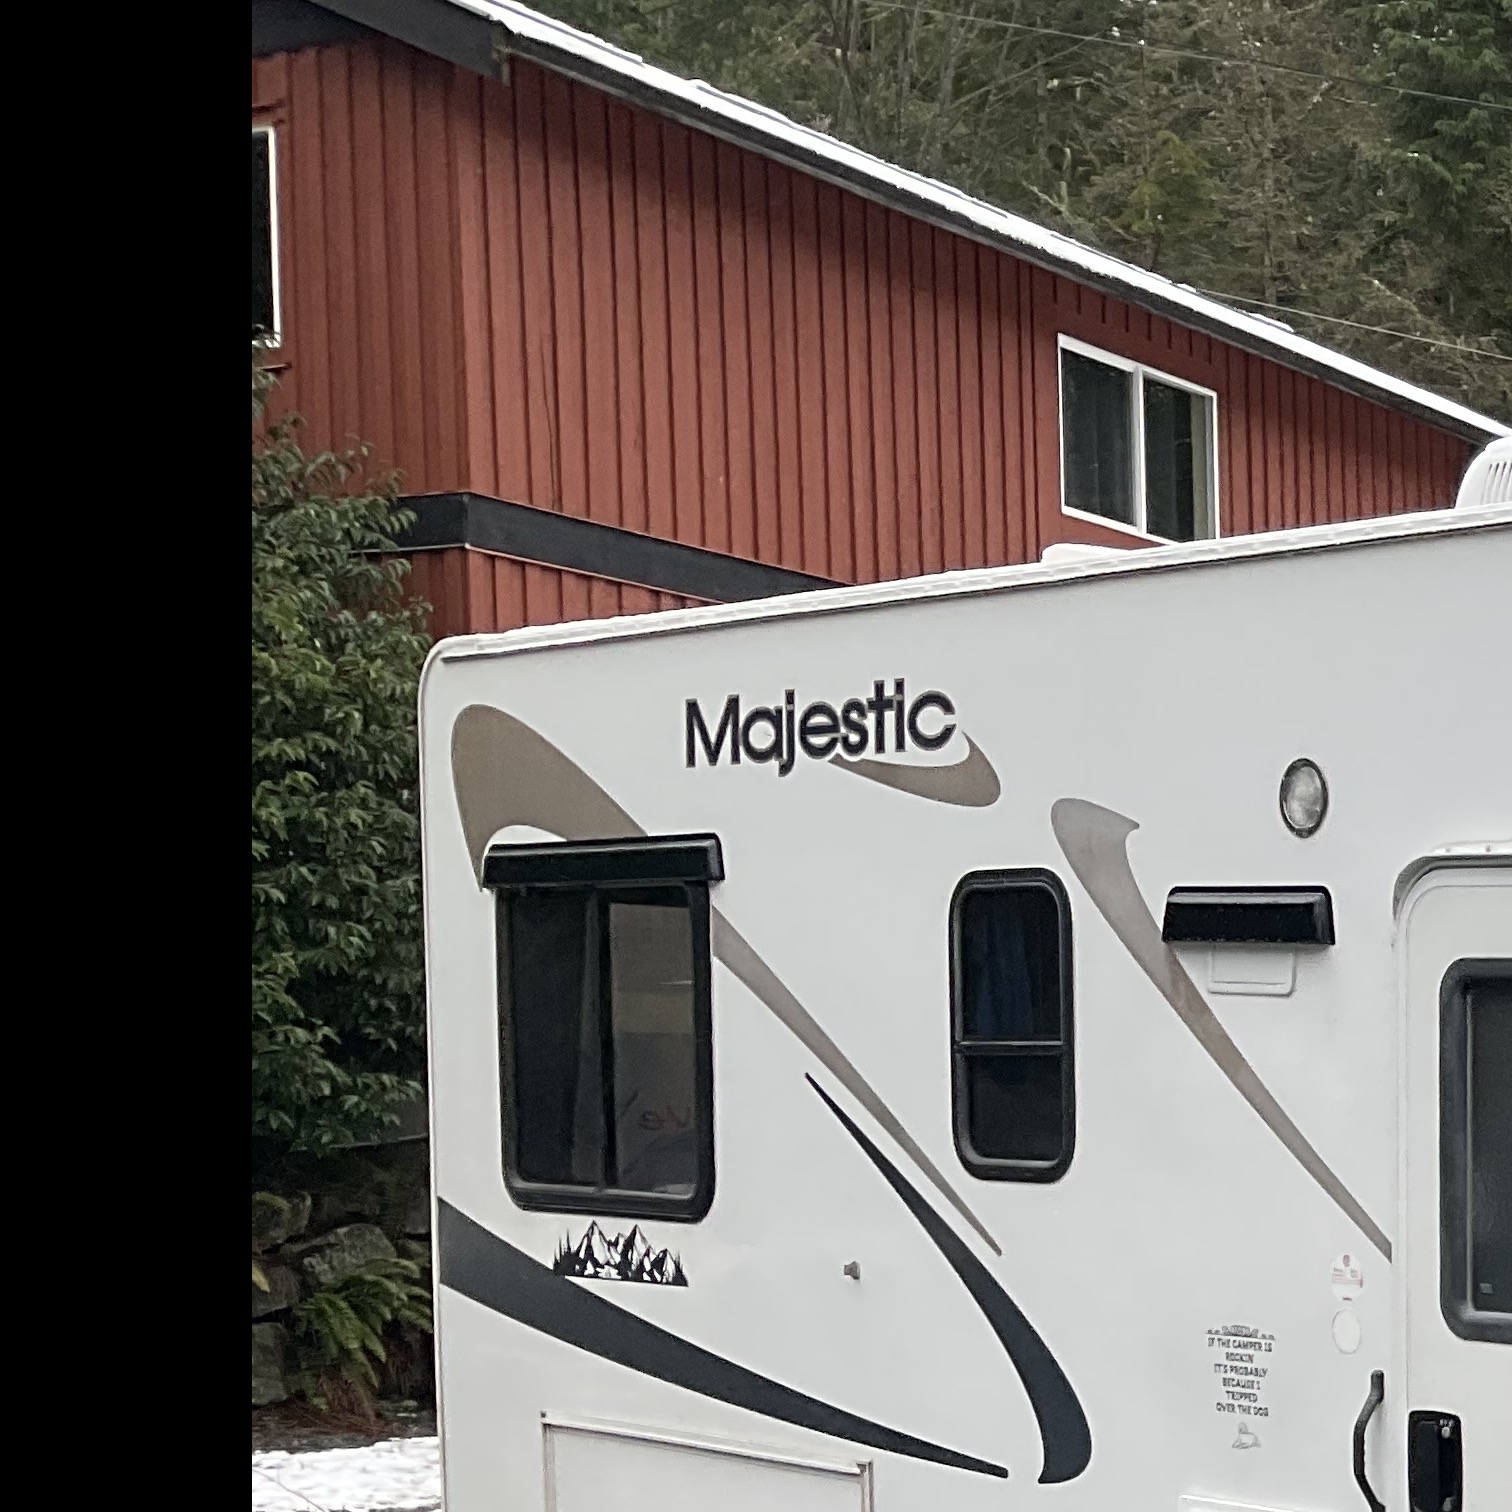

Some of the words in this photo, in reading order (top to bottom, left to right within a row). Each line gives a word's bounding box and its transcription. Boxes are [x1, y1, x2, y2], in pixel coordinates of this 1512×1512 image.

[684, 677, 957, 778] Majestic
[1217, 1338, 1231, 1348] THE
[1232, 1339, 1263, 1352] CAMPER
[1264, 1342, 1272, 1352] IS
[1229, 1365, 1268, 1378] PROBABLY
[1222, 1377, 1255, 1390] BECAUSE
[1225, 1390, 1258, 1403] TRIPPED
[1216, 1402, 1236, 1413] OVER
[1237, 1403, 1252, 1415] THE
[1253, 1406, 1269, 1416] DOG
